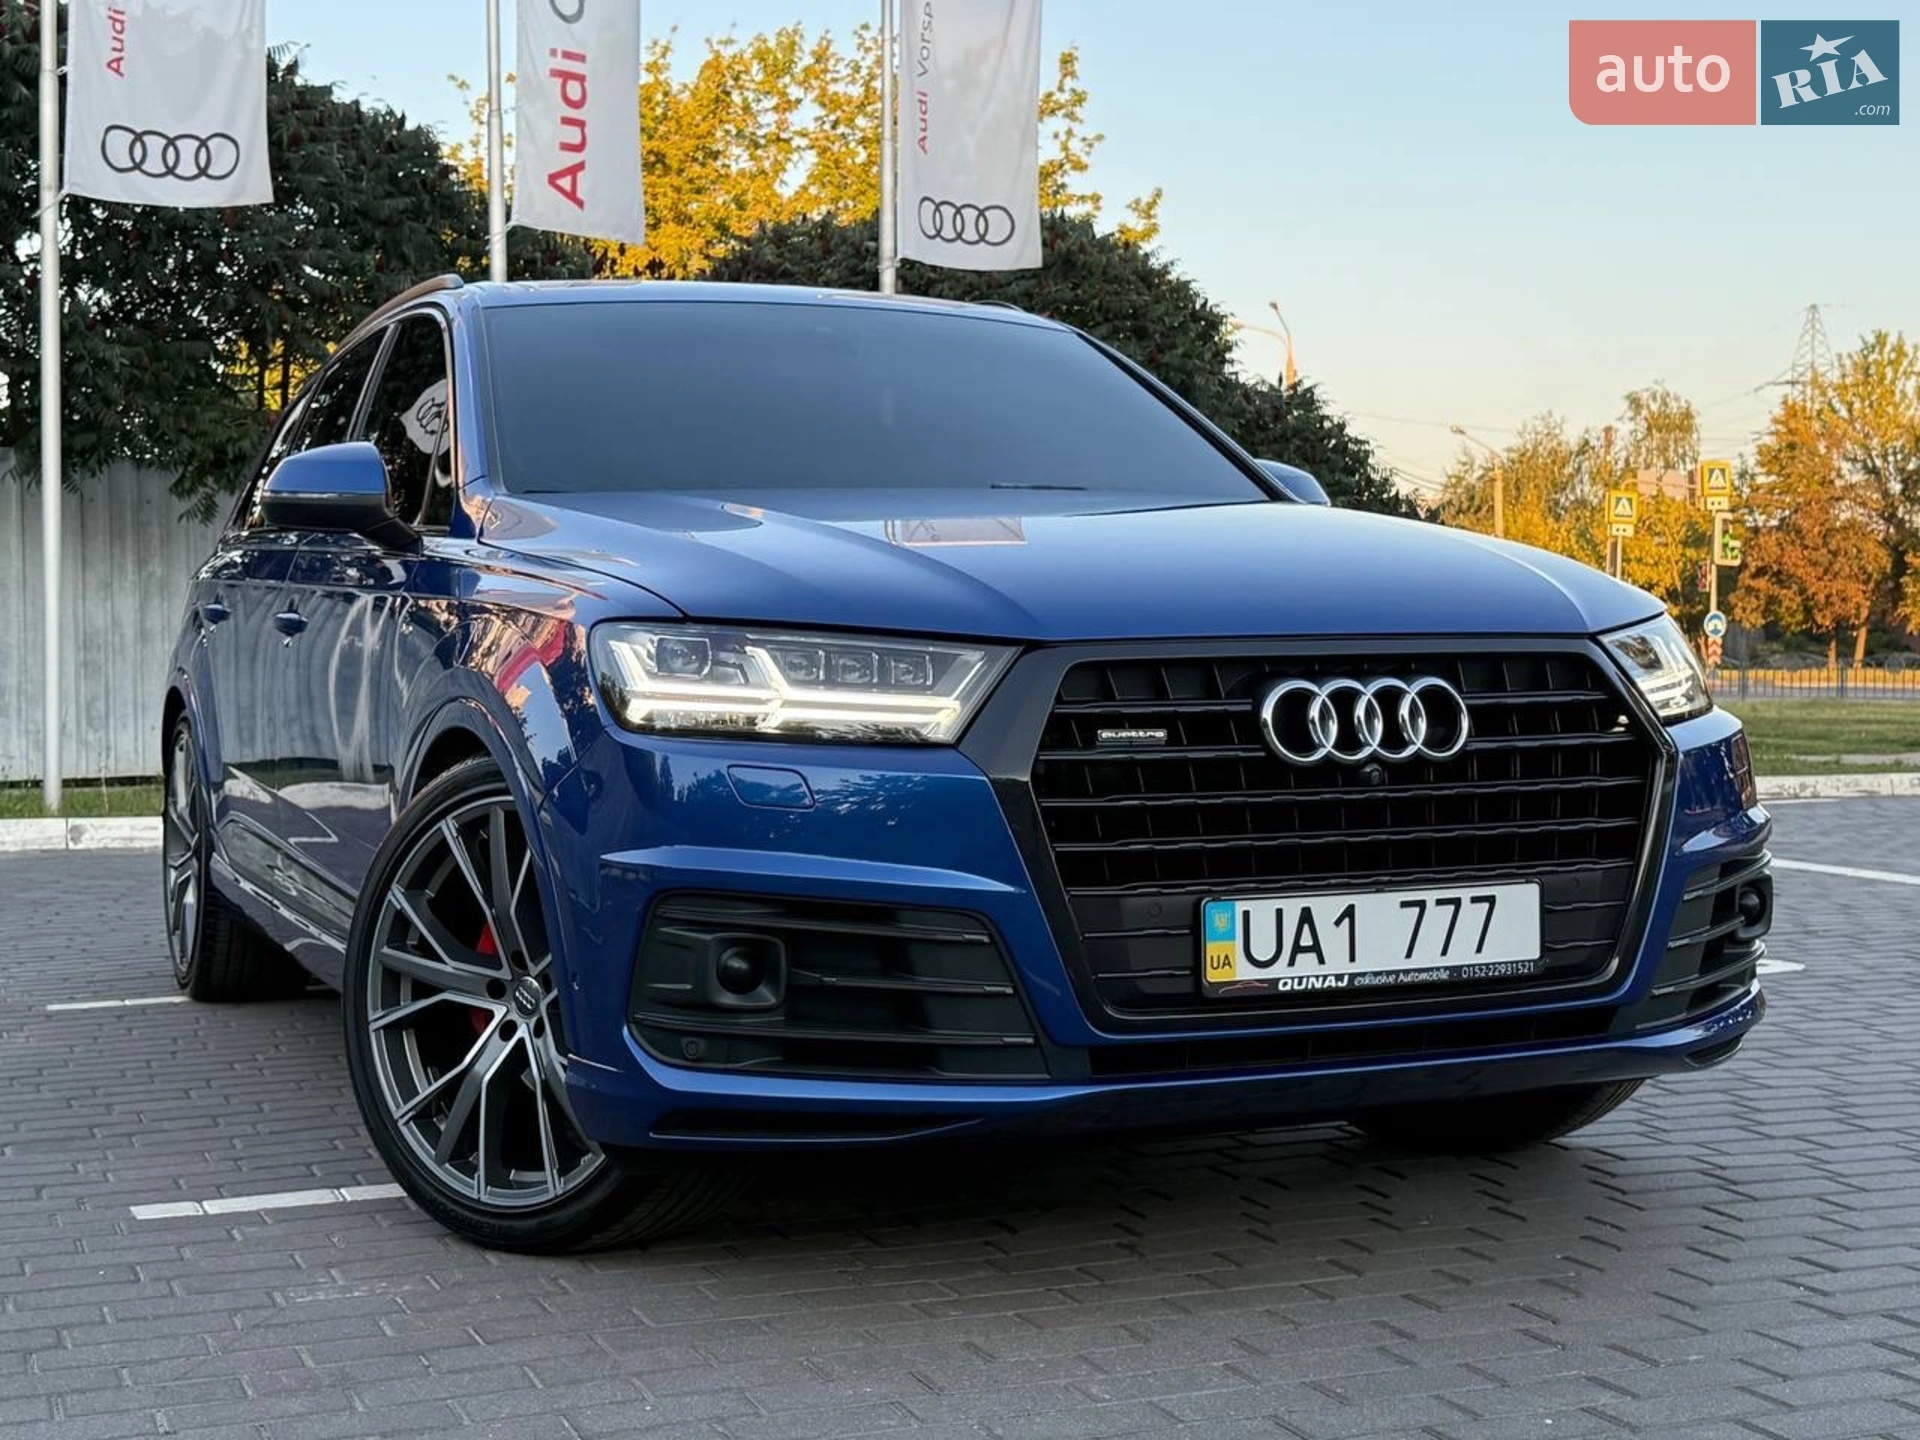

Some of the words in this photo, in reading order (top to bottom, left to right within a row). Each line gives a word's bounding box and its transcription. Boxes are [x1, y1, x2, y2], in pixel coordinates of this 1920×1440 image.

[107, 7, 125, 77] Audi
[548, 47, 586, 211] Audi
[917, 91, 928, 155] Audi
[1210, 954, 1232, 970] UA
[1242, 903, 1356, 969] UA1
[1400, 895, 1496, 959] 777
